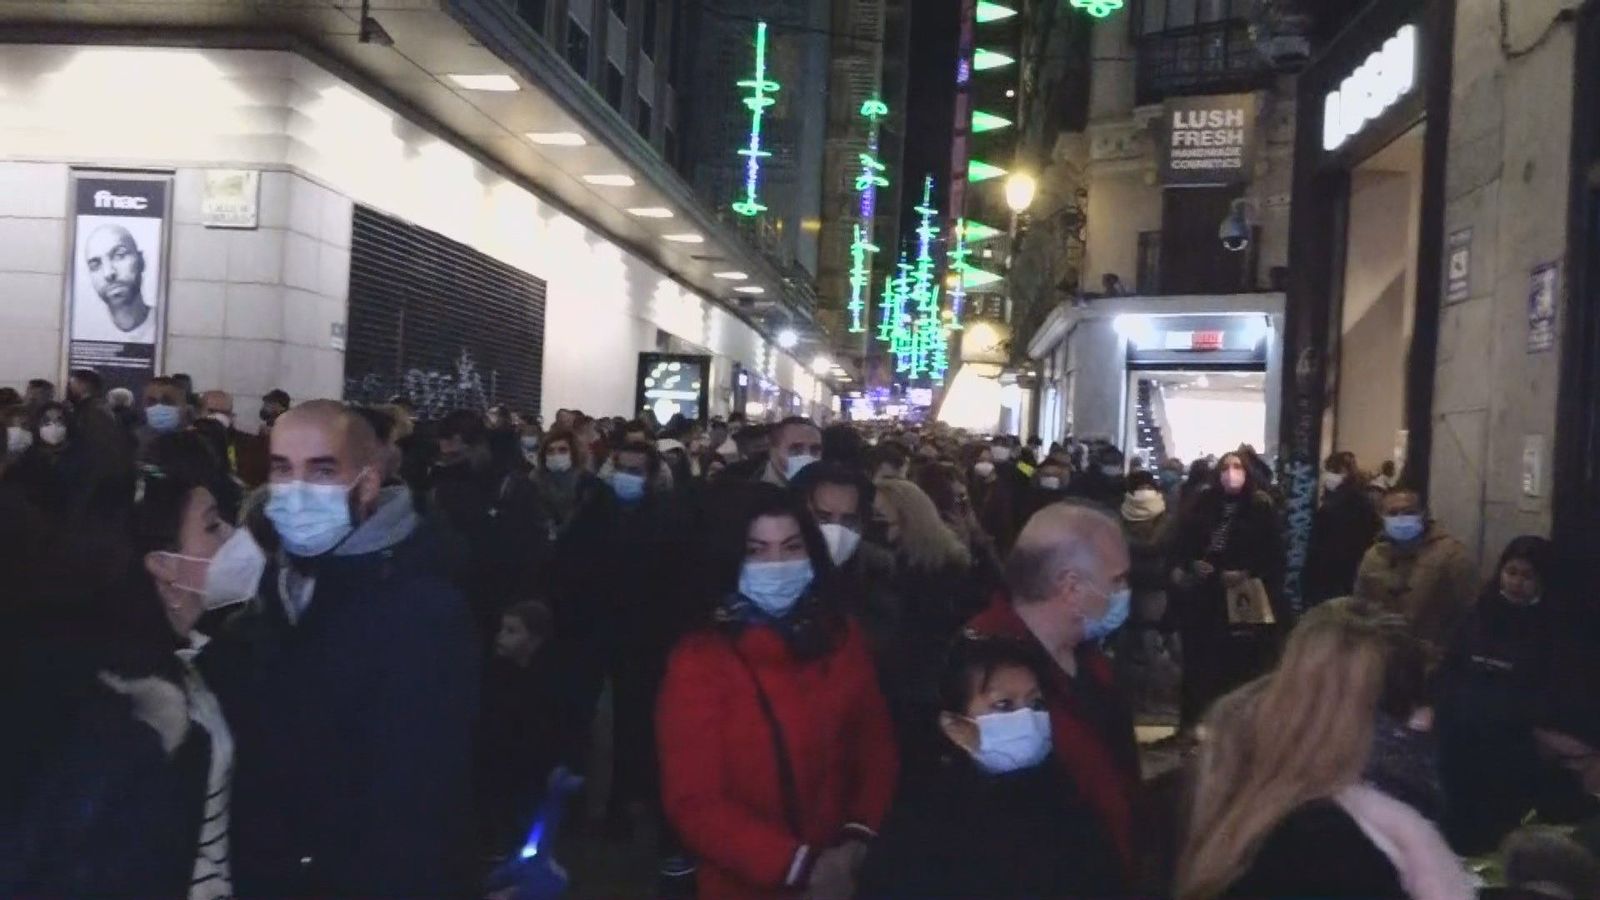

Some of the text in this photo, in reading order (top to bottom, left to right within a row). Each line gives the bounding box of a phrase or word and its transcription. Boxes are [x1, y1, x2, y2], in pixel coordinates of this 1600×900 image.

[1173, 109, 1244, 129] LUSH
[1172, 129, 1243, 147] FRESH
[93, 190, 149, 210] fnac
